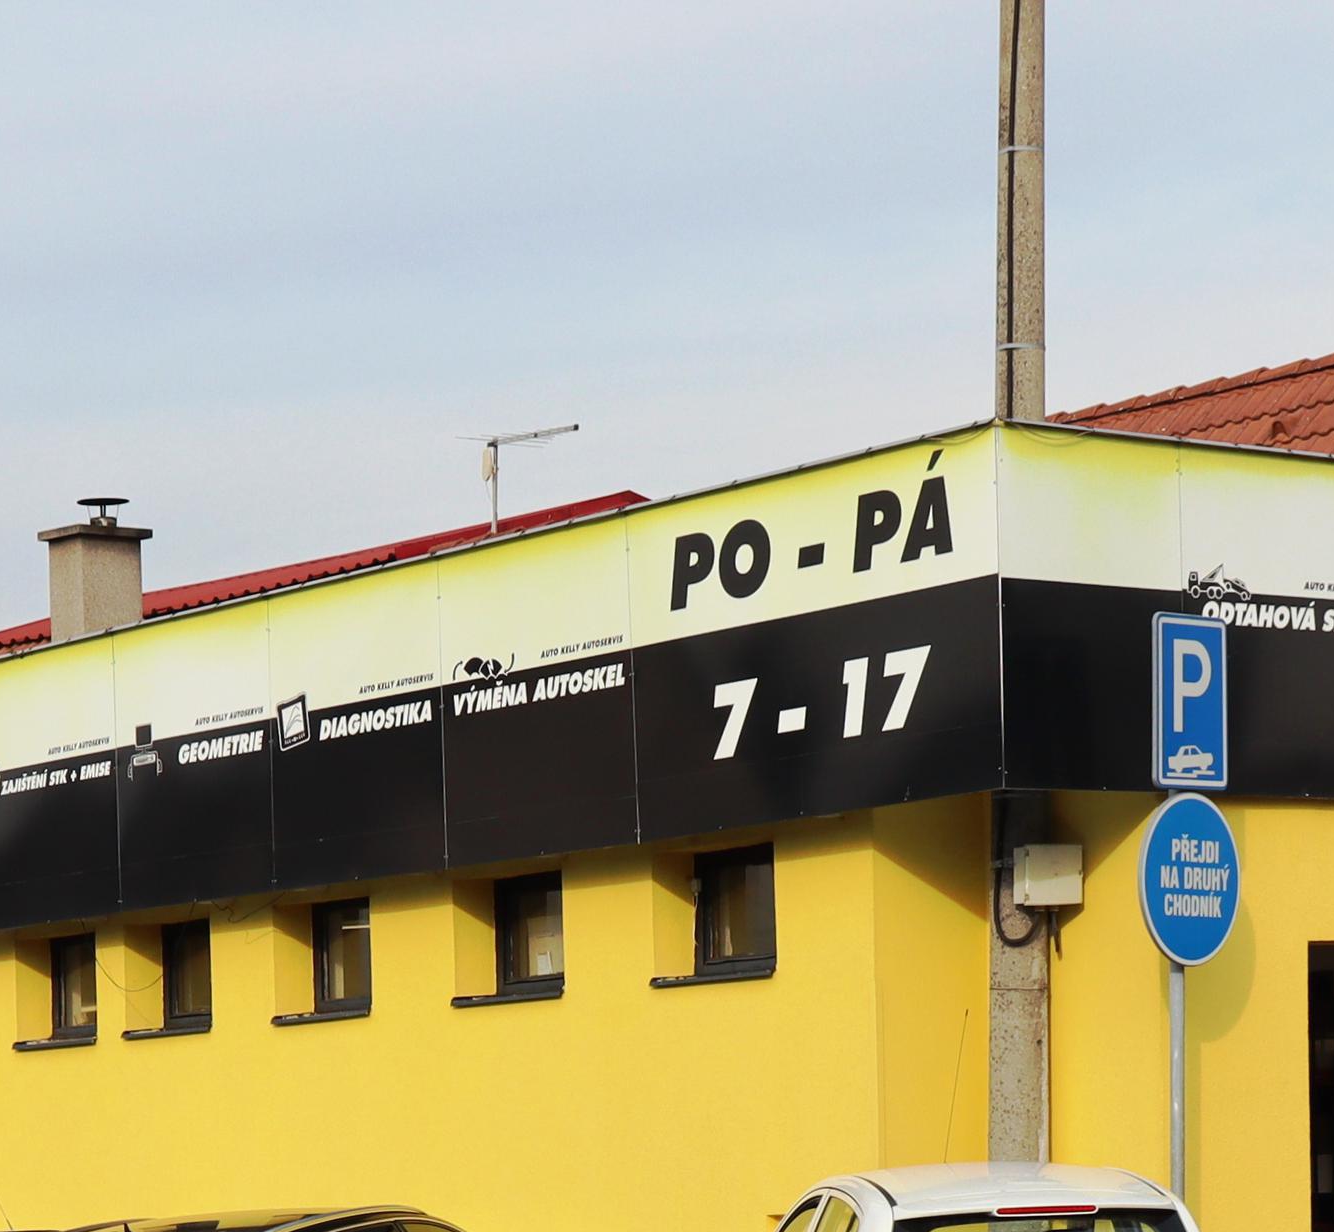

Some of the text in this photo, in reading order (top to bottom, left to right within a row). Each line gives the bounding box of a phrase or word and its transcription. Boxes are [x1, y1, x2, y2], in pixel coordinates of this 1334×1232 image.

[670, 448, 953, 612] PO - PÁ
[1304, 582, 1325, 591] AUTO
[1202, 600, 1316, 631] ODTAHOVÁ
[540, 635, 624, 659] AUTO KELLY AUTOSERVIS
[359, 673, 434, 694] AUTO KELLY AUTOSERVIS
[453, 663, 625, 717] VÝMĚNA AUTOSKEL
[1173, 638, 1212, 733] P
[713, 644, 932, 760] 7 - 17
[195, 717, 210, 726] AUTO
[212, 713, 228, 723] KELLY
[319, 700, 432, 741] DIAGNOSTIKA
[178, 730, 264, 765] GEOMETRIE
[0, 769, 47, 796] ZAJIŠTĚNÍ
[49, 769, 68, 786] STK
[80, 761, 111, 781] EMISE
[1171, 834, 1219, 864] PŘEJDI
[1160, 864, 1230, 891] NA DRUHÝ
[1163, 892, 1222, 919] CHODNÍK
